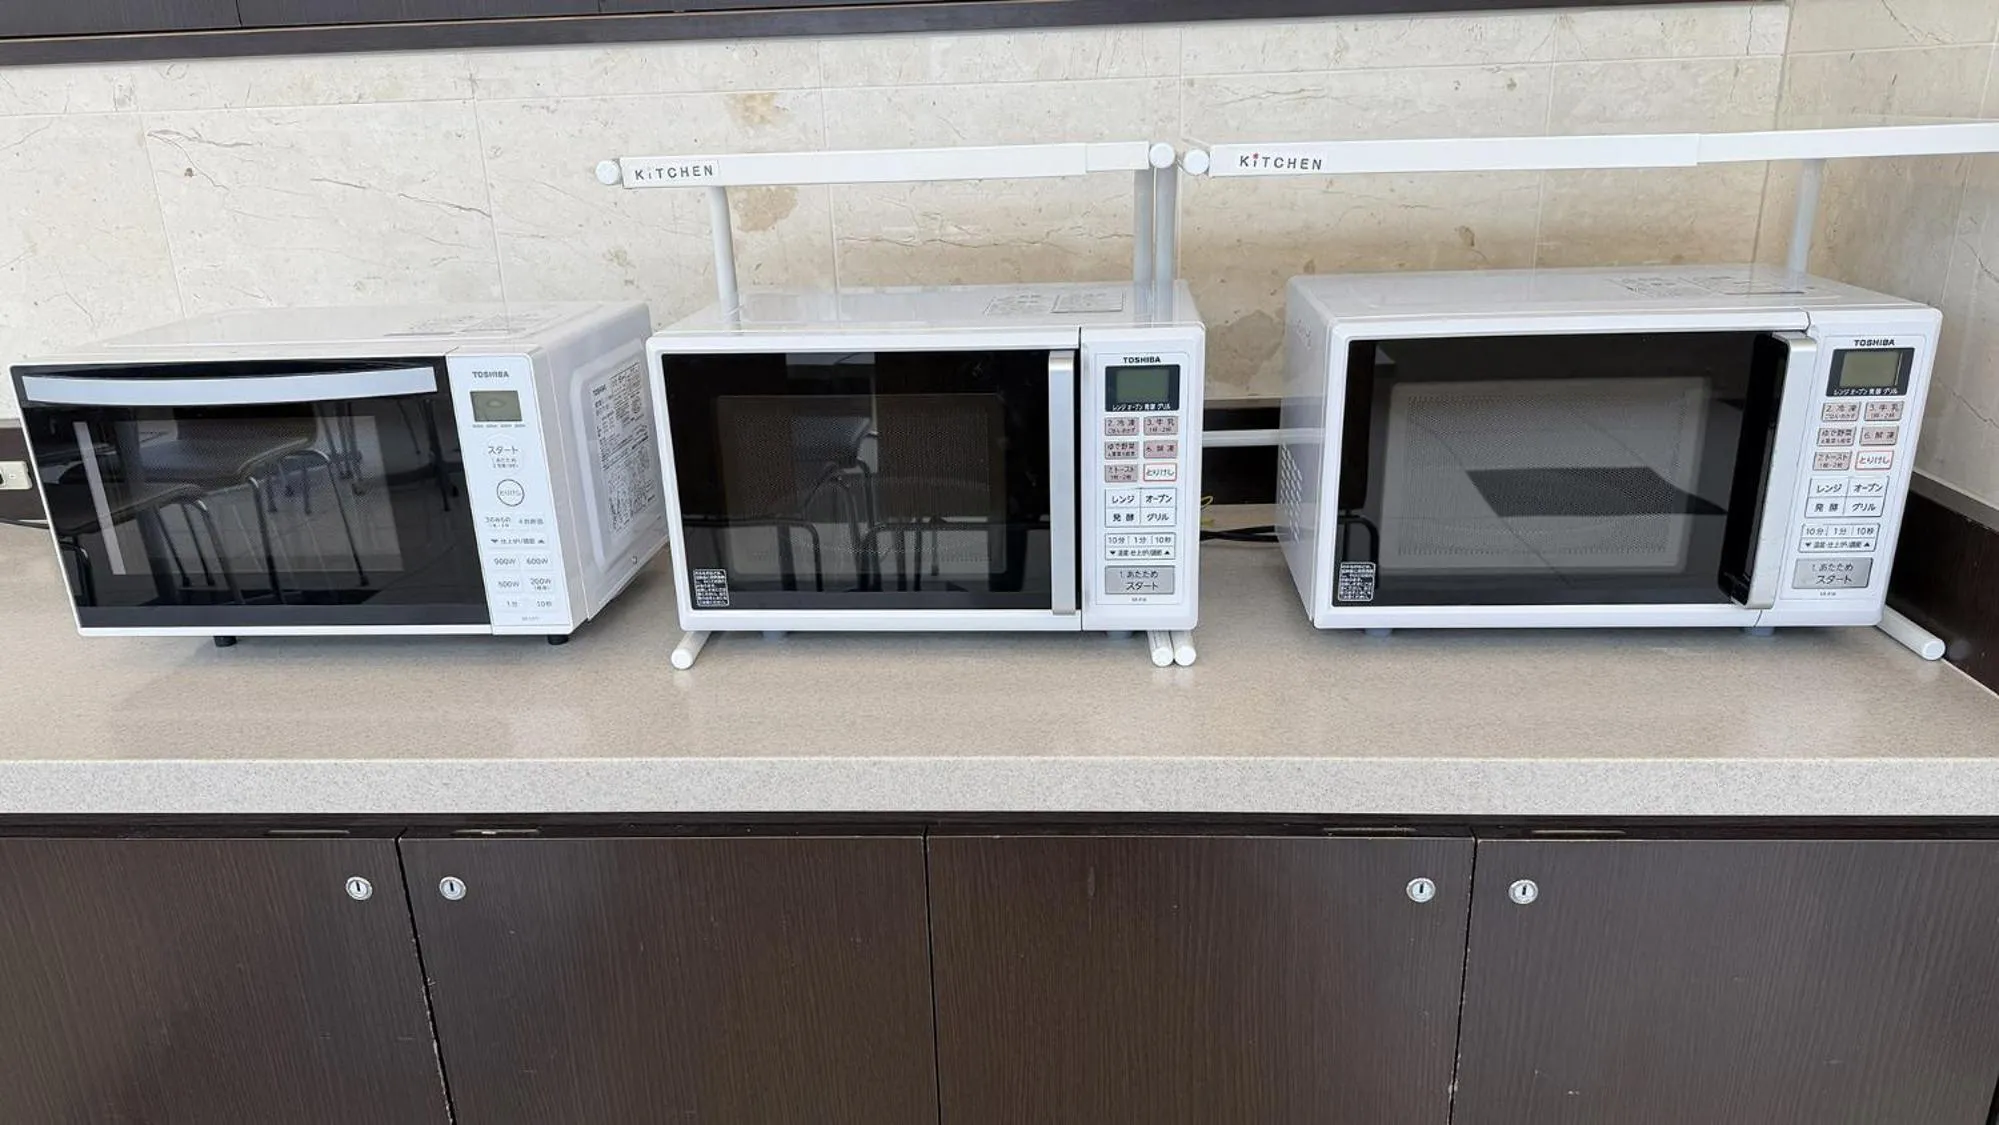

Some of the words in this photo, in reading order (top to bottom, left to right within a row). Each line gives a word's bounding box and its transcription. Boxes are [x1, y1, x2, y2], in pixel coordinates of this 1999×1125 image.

[1853, 338, 1896, 347] TOSHIBA
[1122, 355, 1162, 364] TOSHIBA
[471, 370, 510, 379] TOSHIBA
[487, 445, 519, 455] スタート
[1860, 455, 1890, 465] とりけし
[1146, 467, 1175, 477] とりけし
[1816, 483, 1843, 493] レンジ
[1853, 483, 1883, 493] オープン
[1111, 495, 1135, 504] レンジ
[1145, 493, 1173, 503] オープン
[1852, 502, 1876, 512] グリル
[1146, 512, 1170, 521] グリル
[1816, 575, 1852, 585] スタート
[1125, 581, 1159, 591] スタート
